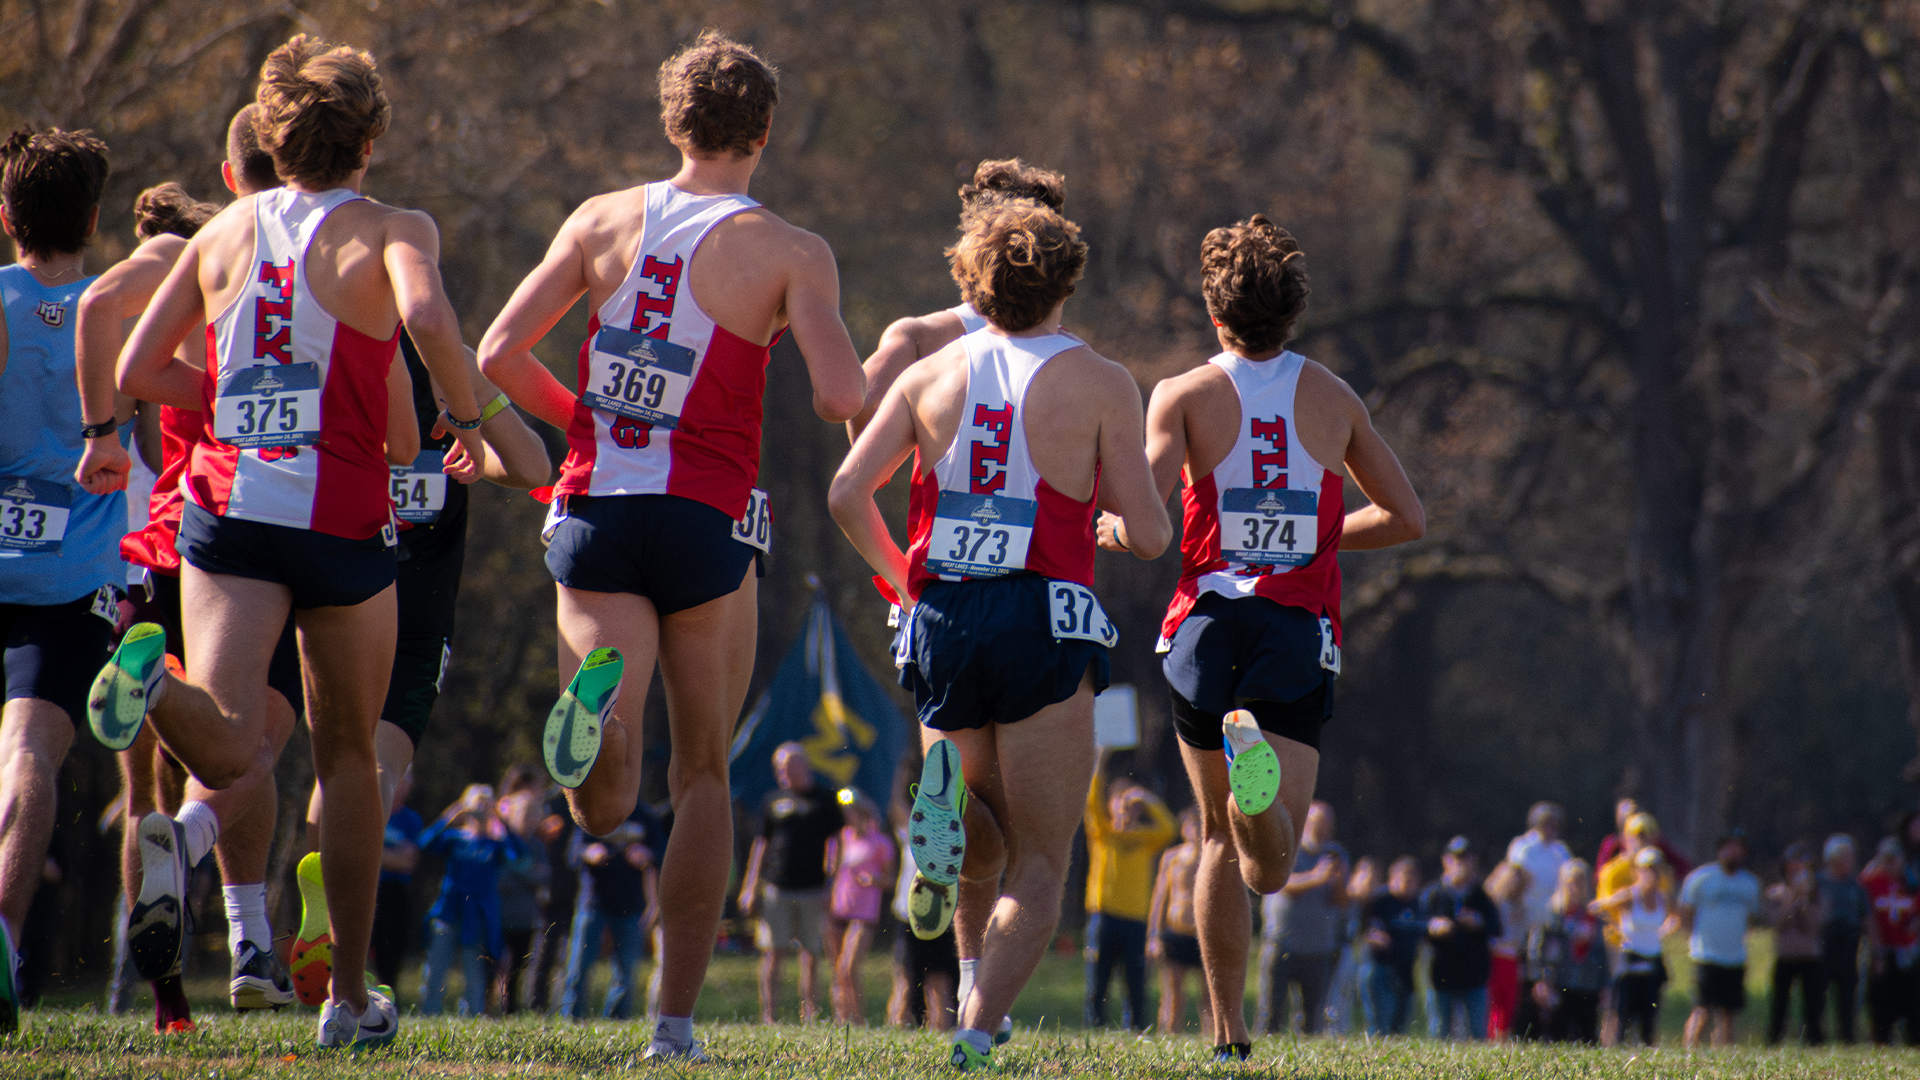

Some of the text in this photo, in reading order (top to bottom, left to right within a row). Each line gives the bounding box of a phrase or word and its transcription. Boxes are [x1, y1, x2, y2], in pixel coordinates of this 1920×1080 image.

[35, 299, 66, 327] MU
[603, 362, 666, 408] 369
[237, 397, 298, 434] 375
[392, 479, 429, 508] 54
[0, 505, 47, 539] 33
[1242, 517, 1297, 551] 374
[949, 526, 1010, 565] 373
